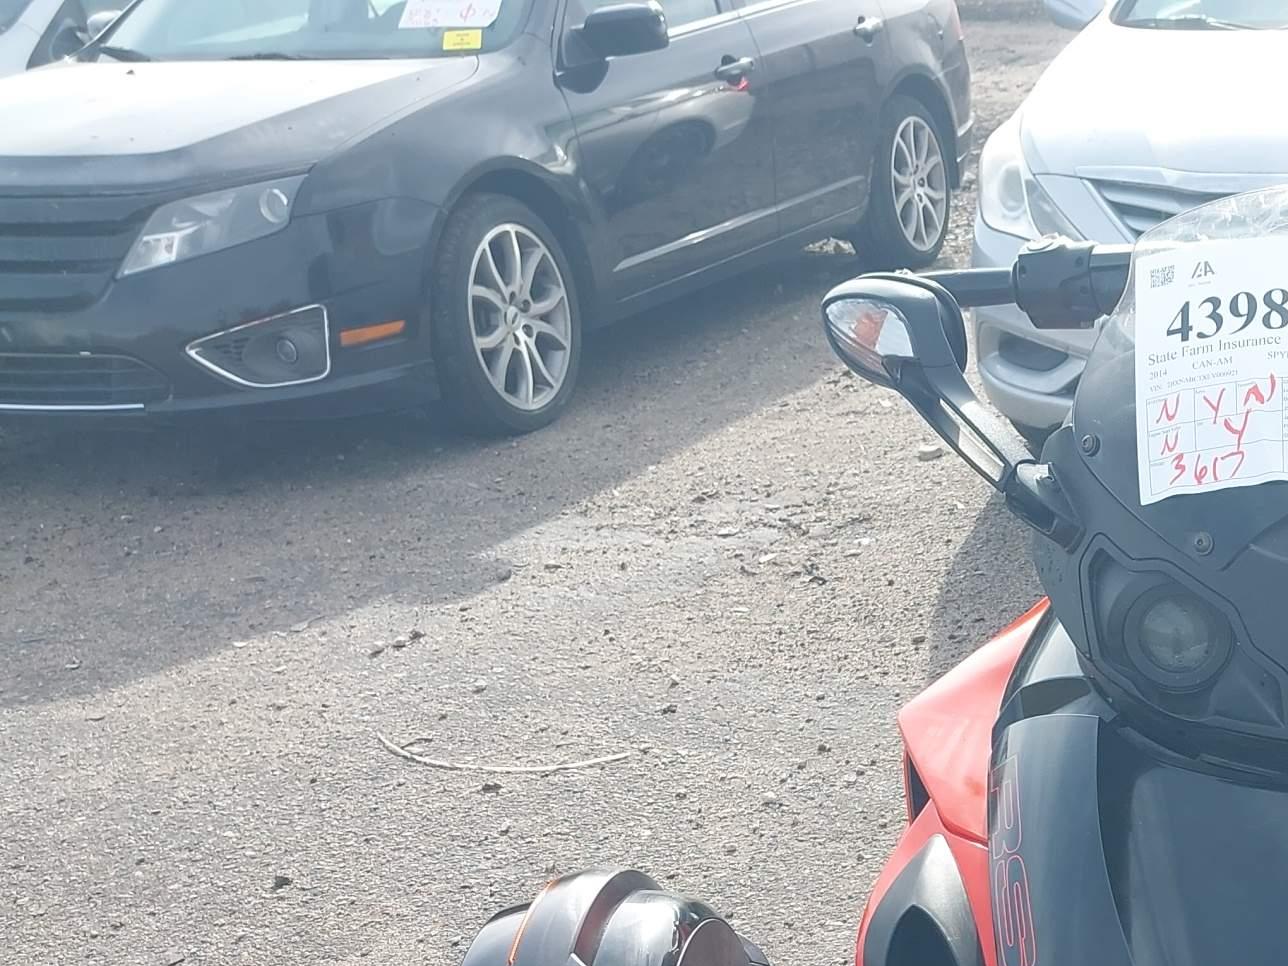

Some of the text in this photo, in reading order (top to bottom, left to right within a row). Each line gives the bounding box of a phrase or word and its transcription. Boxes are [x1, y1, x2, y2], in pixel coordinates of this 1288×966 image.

[1148, 335, 1282, 366] State Farm Insurance
[1149, 368, 1168, 381] 2014
[1192, 356, 1233, 370] CAN-AM
[1156, 372, 1277, 424] N Y N
